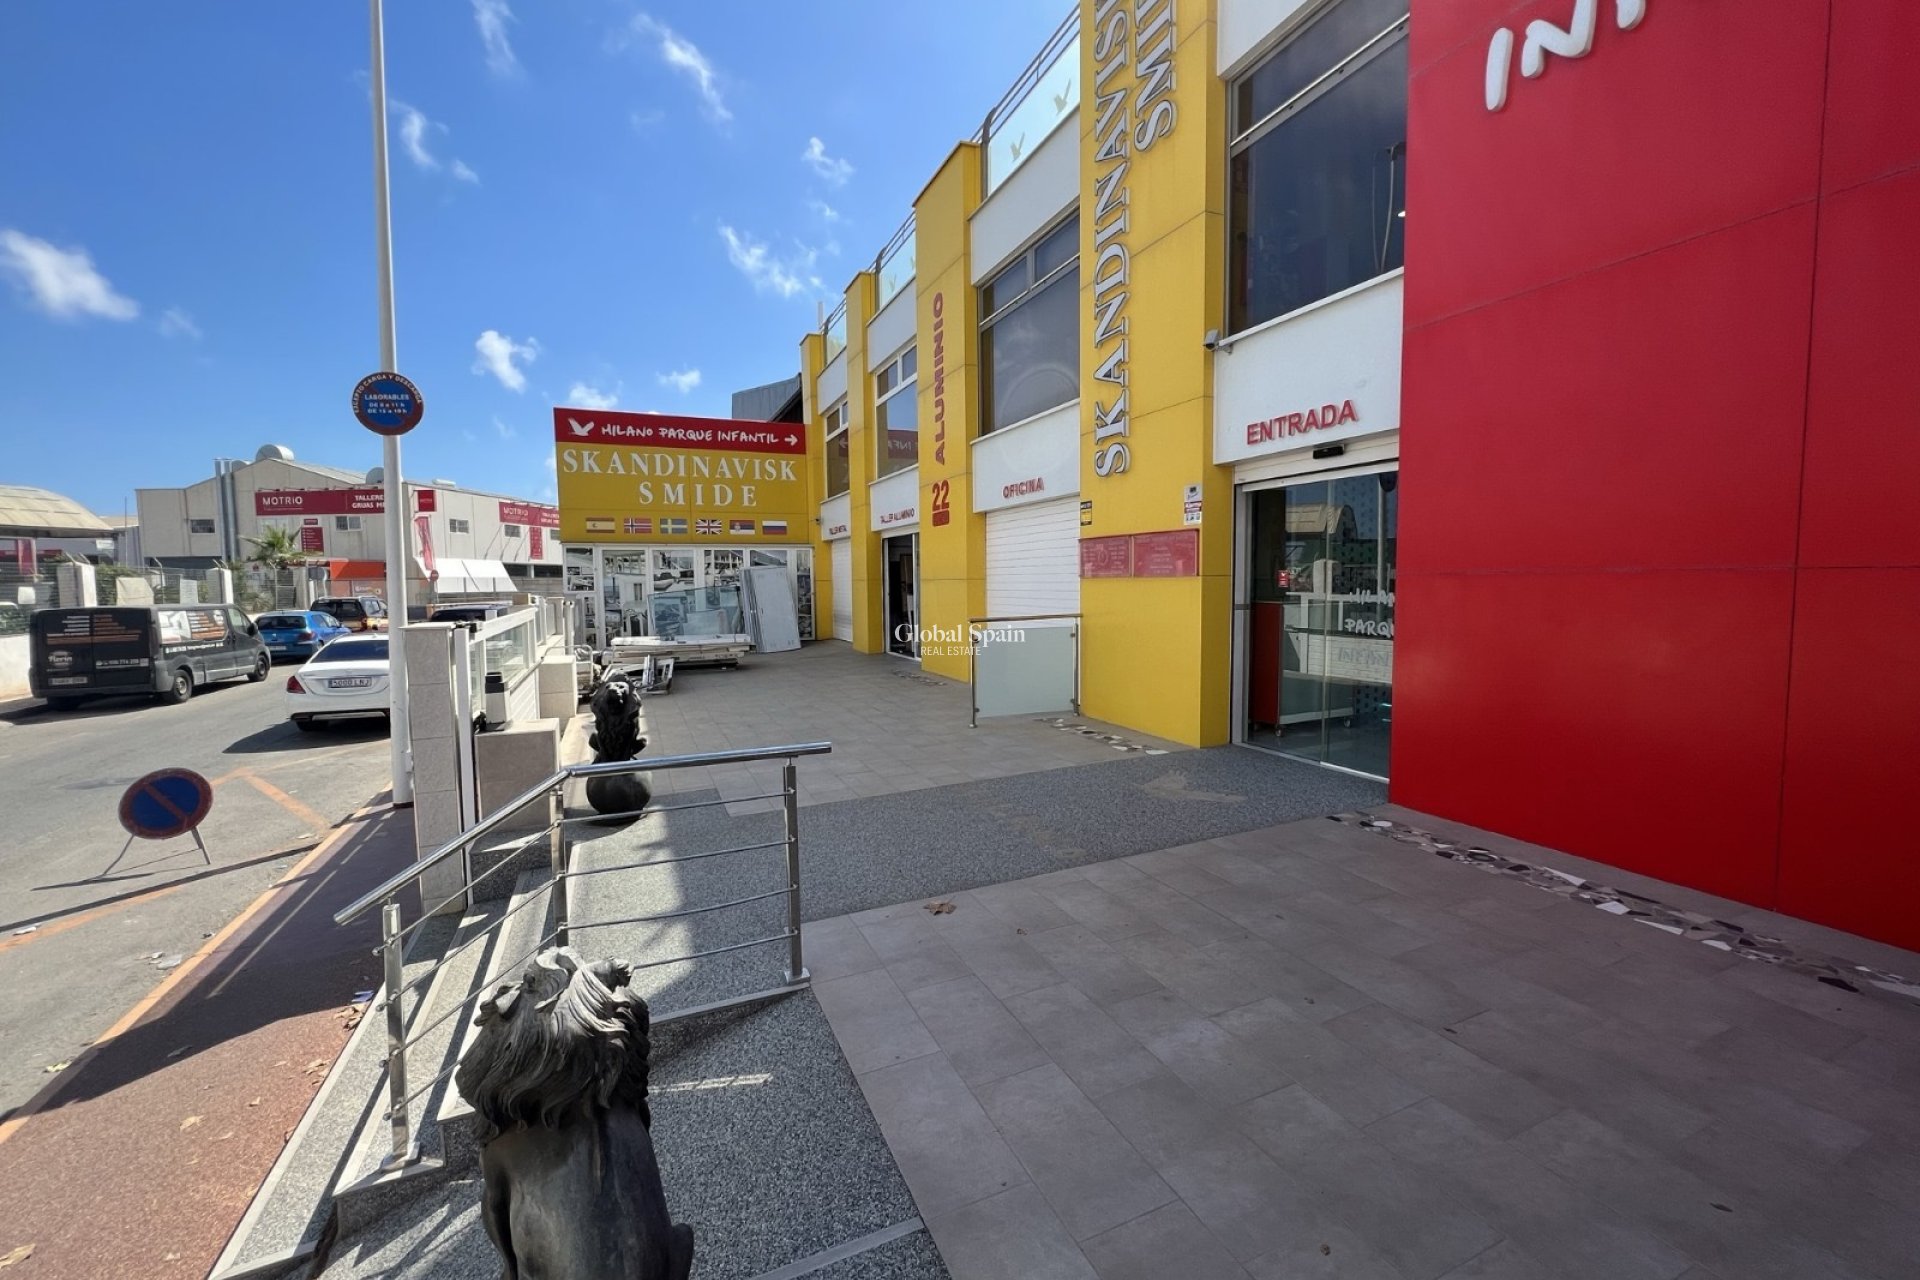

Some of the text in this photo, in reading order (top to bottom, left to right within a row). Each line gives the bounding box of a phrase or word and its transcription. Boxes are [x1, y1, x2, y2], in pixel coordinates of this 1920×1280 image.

[1485, 0, 1647, 112] IN
[933, 292, 945, 467] ALUMINIO
[601, 423, 779, 444] MILANO PARQUE INFANTIL
[1247, 399, 1359, 446] ENTRADA
[563, 449, 798, 482] SKANDINAVISK
[639, 481, 757, 508] SMIDE
[932, 480, 950, 512] 22
[1002, 477, 1045, 499] OFICINA
